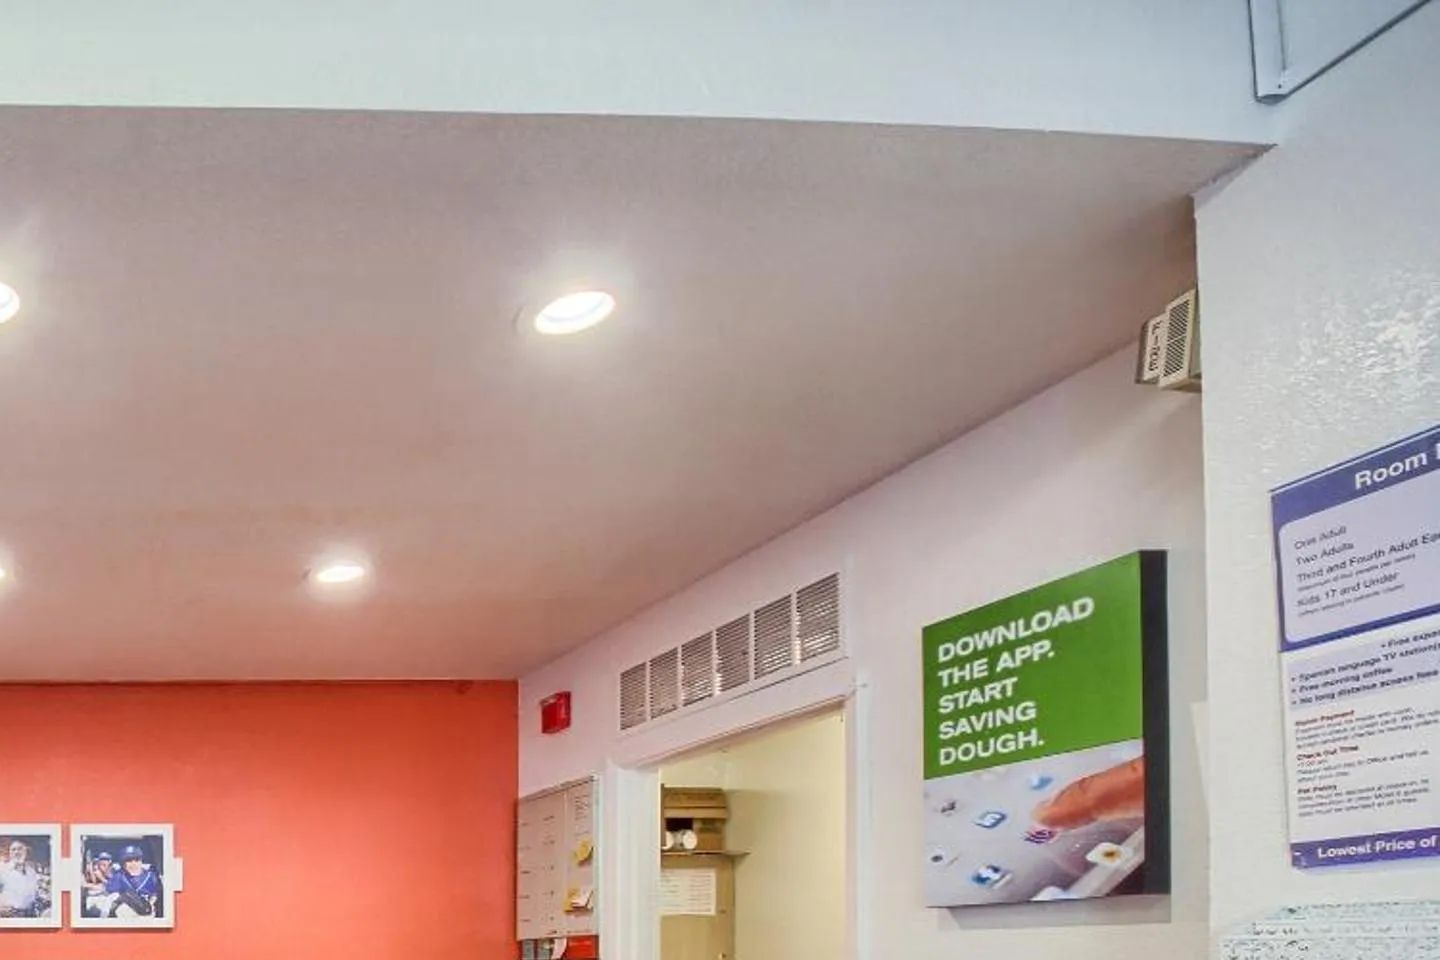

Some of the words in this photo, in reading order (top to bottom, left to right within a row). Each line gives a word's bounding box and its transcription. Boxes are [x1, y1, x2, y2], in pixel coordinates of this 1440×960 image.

[1354, 452, 1428, 490] Room
[1349, 549, 1385, 568] Fourth
[937, 597, 1096, 664] DOWNLOAD
[937, 658, 989, 689] THE
[996, 639, 1056, 673] APP.
[938, 676, 1019, 714] START
[938, 701, 1038, 741] SAVING
[939, 728, 1045, 766] DOUGH.
[1317, 842, 1373, 859] Lowest
[1375, 839, 1416, 853] Price
[1420, 834, 1438, 848] of
